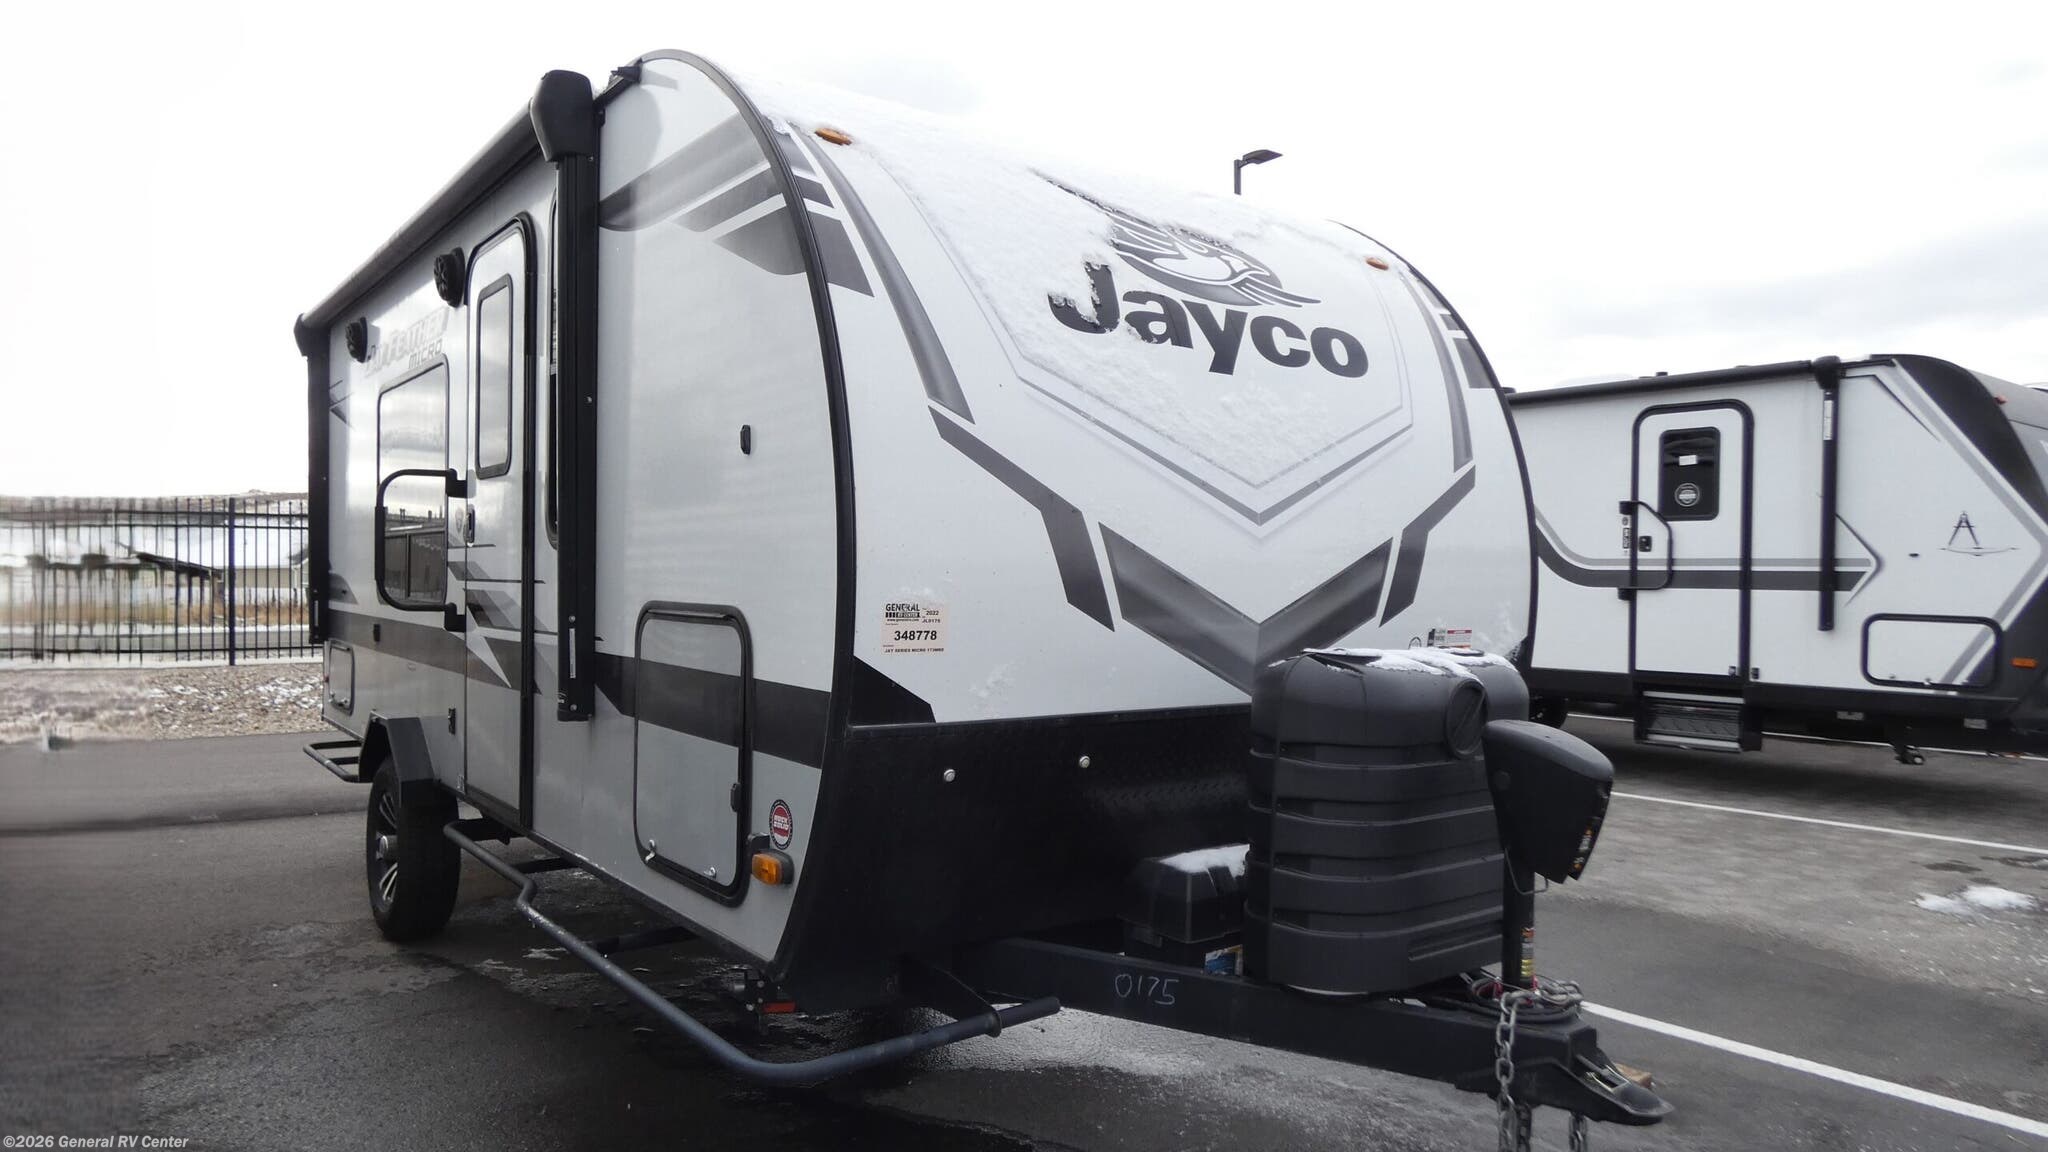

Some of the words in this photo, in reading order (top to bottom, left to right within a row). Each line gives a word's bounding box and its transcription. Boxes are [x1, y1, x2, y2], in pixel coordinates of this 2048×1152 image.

[1047, 260, 1369, 378] Jayco
[885, 603, 920, 612] GENERAL
[894, 630, 937, 641] 348778
[1114, 973, 1180, 1005] 0175
